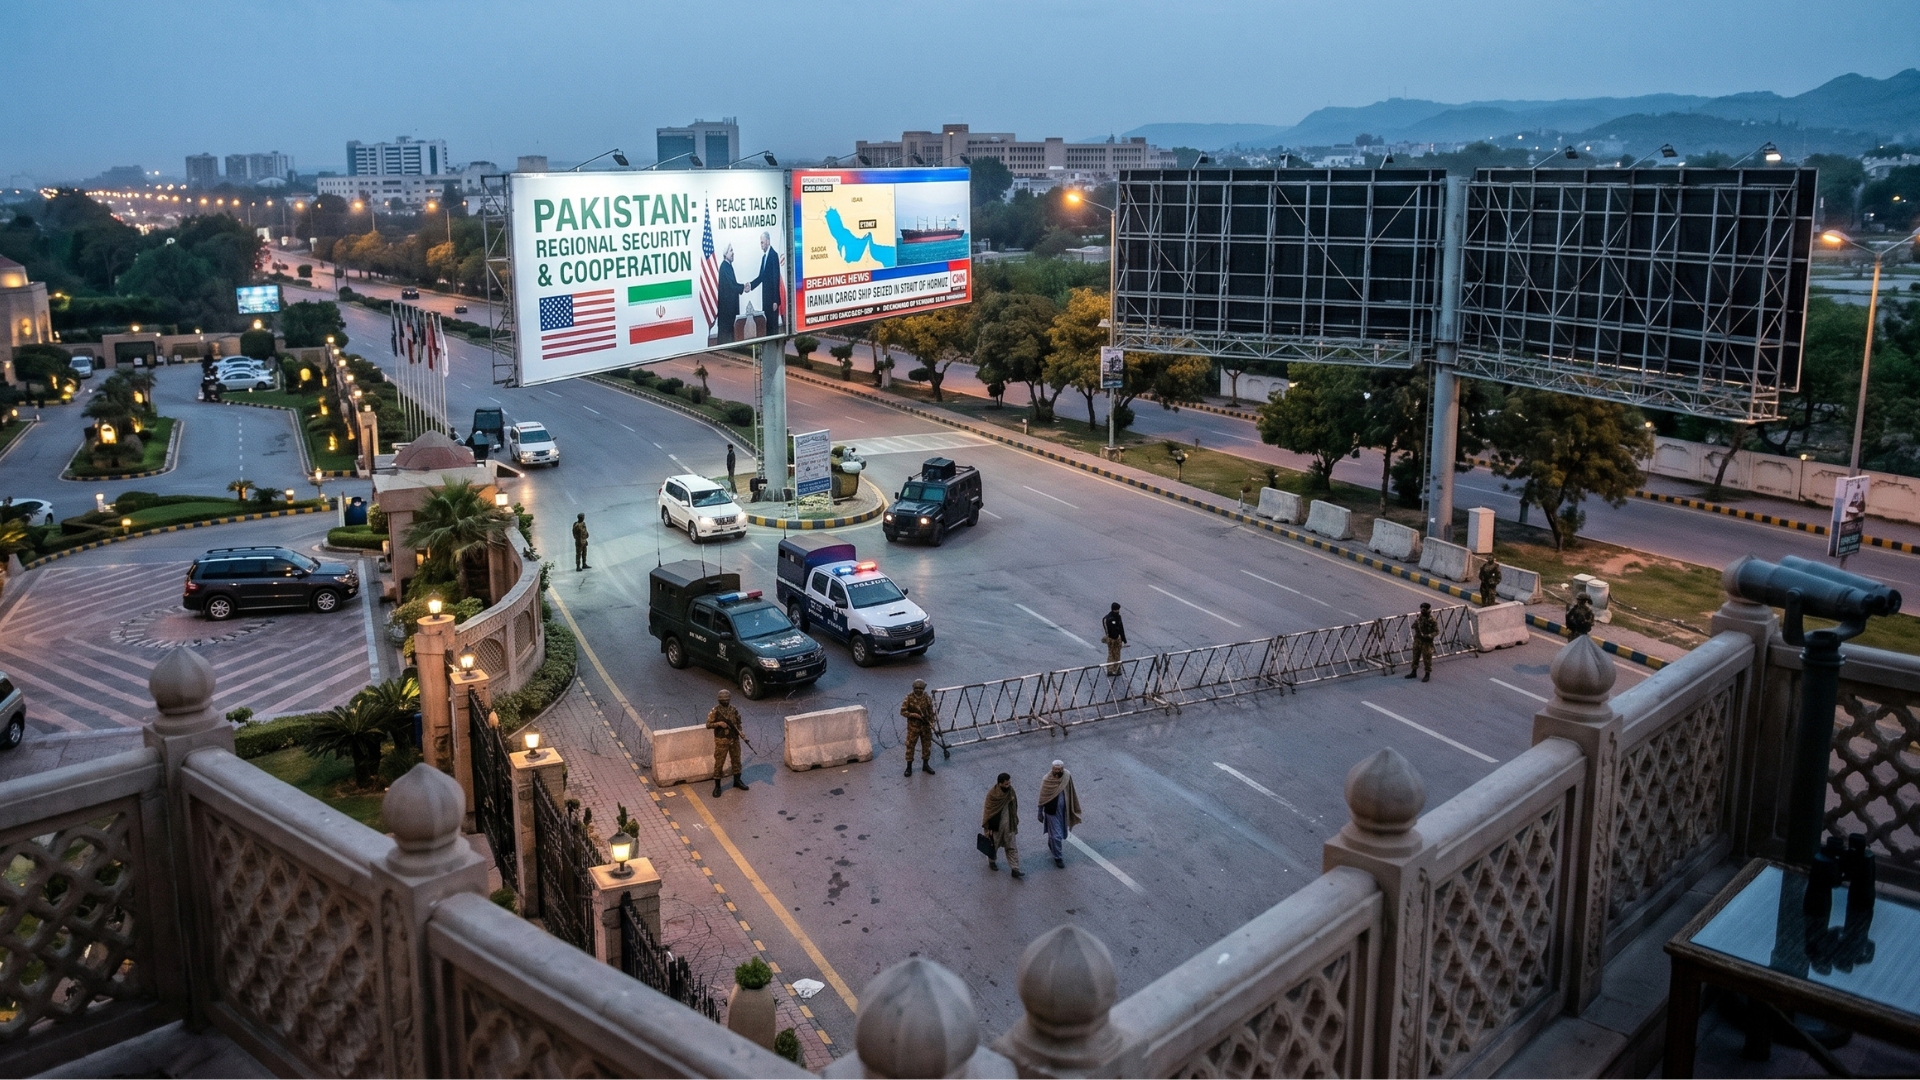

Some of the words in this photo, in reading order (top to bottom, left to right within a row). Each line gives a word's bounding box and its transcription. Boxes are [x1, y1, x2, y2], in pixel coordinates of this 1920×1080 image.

[534, 193, 697, 233] PAKISTAN:
[716, 198, 746, 212] PEACE
[749, 196, 778, 211] TALKS
[718, 216, 727, 230] IN
[729, 213, 777, 230] ISLAMABAD
[536, 234, 617, 258] REGIONAL
[622, 229, 691, 251] SECURITY
[537, 263, 553, 287] &
[559, 251, 692, 285] COOPERATION
[806, 275, 847, 289] BREAKING
[807, 292, 834, 308] IRANIAN
[835, 289, 857, 304] CARGO
[858, 287, 872, 301] SHIP
[873, 284, 893, 298] SEIZED
[894, 283, 900, 295] IN
[900, 281, 918, 293] STRAIT
[919, 280, 926, 291] OF
